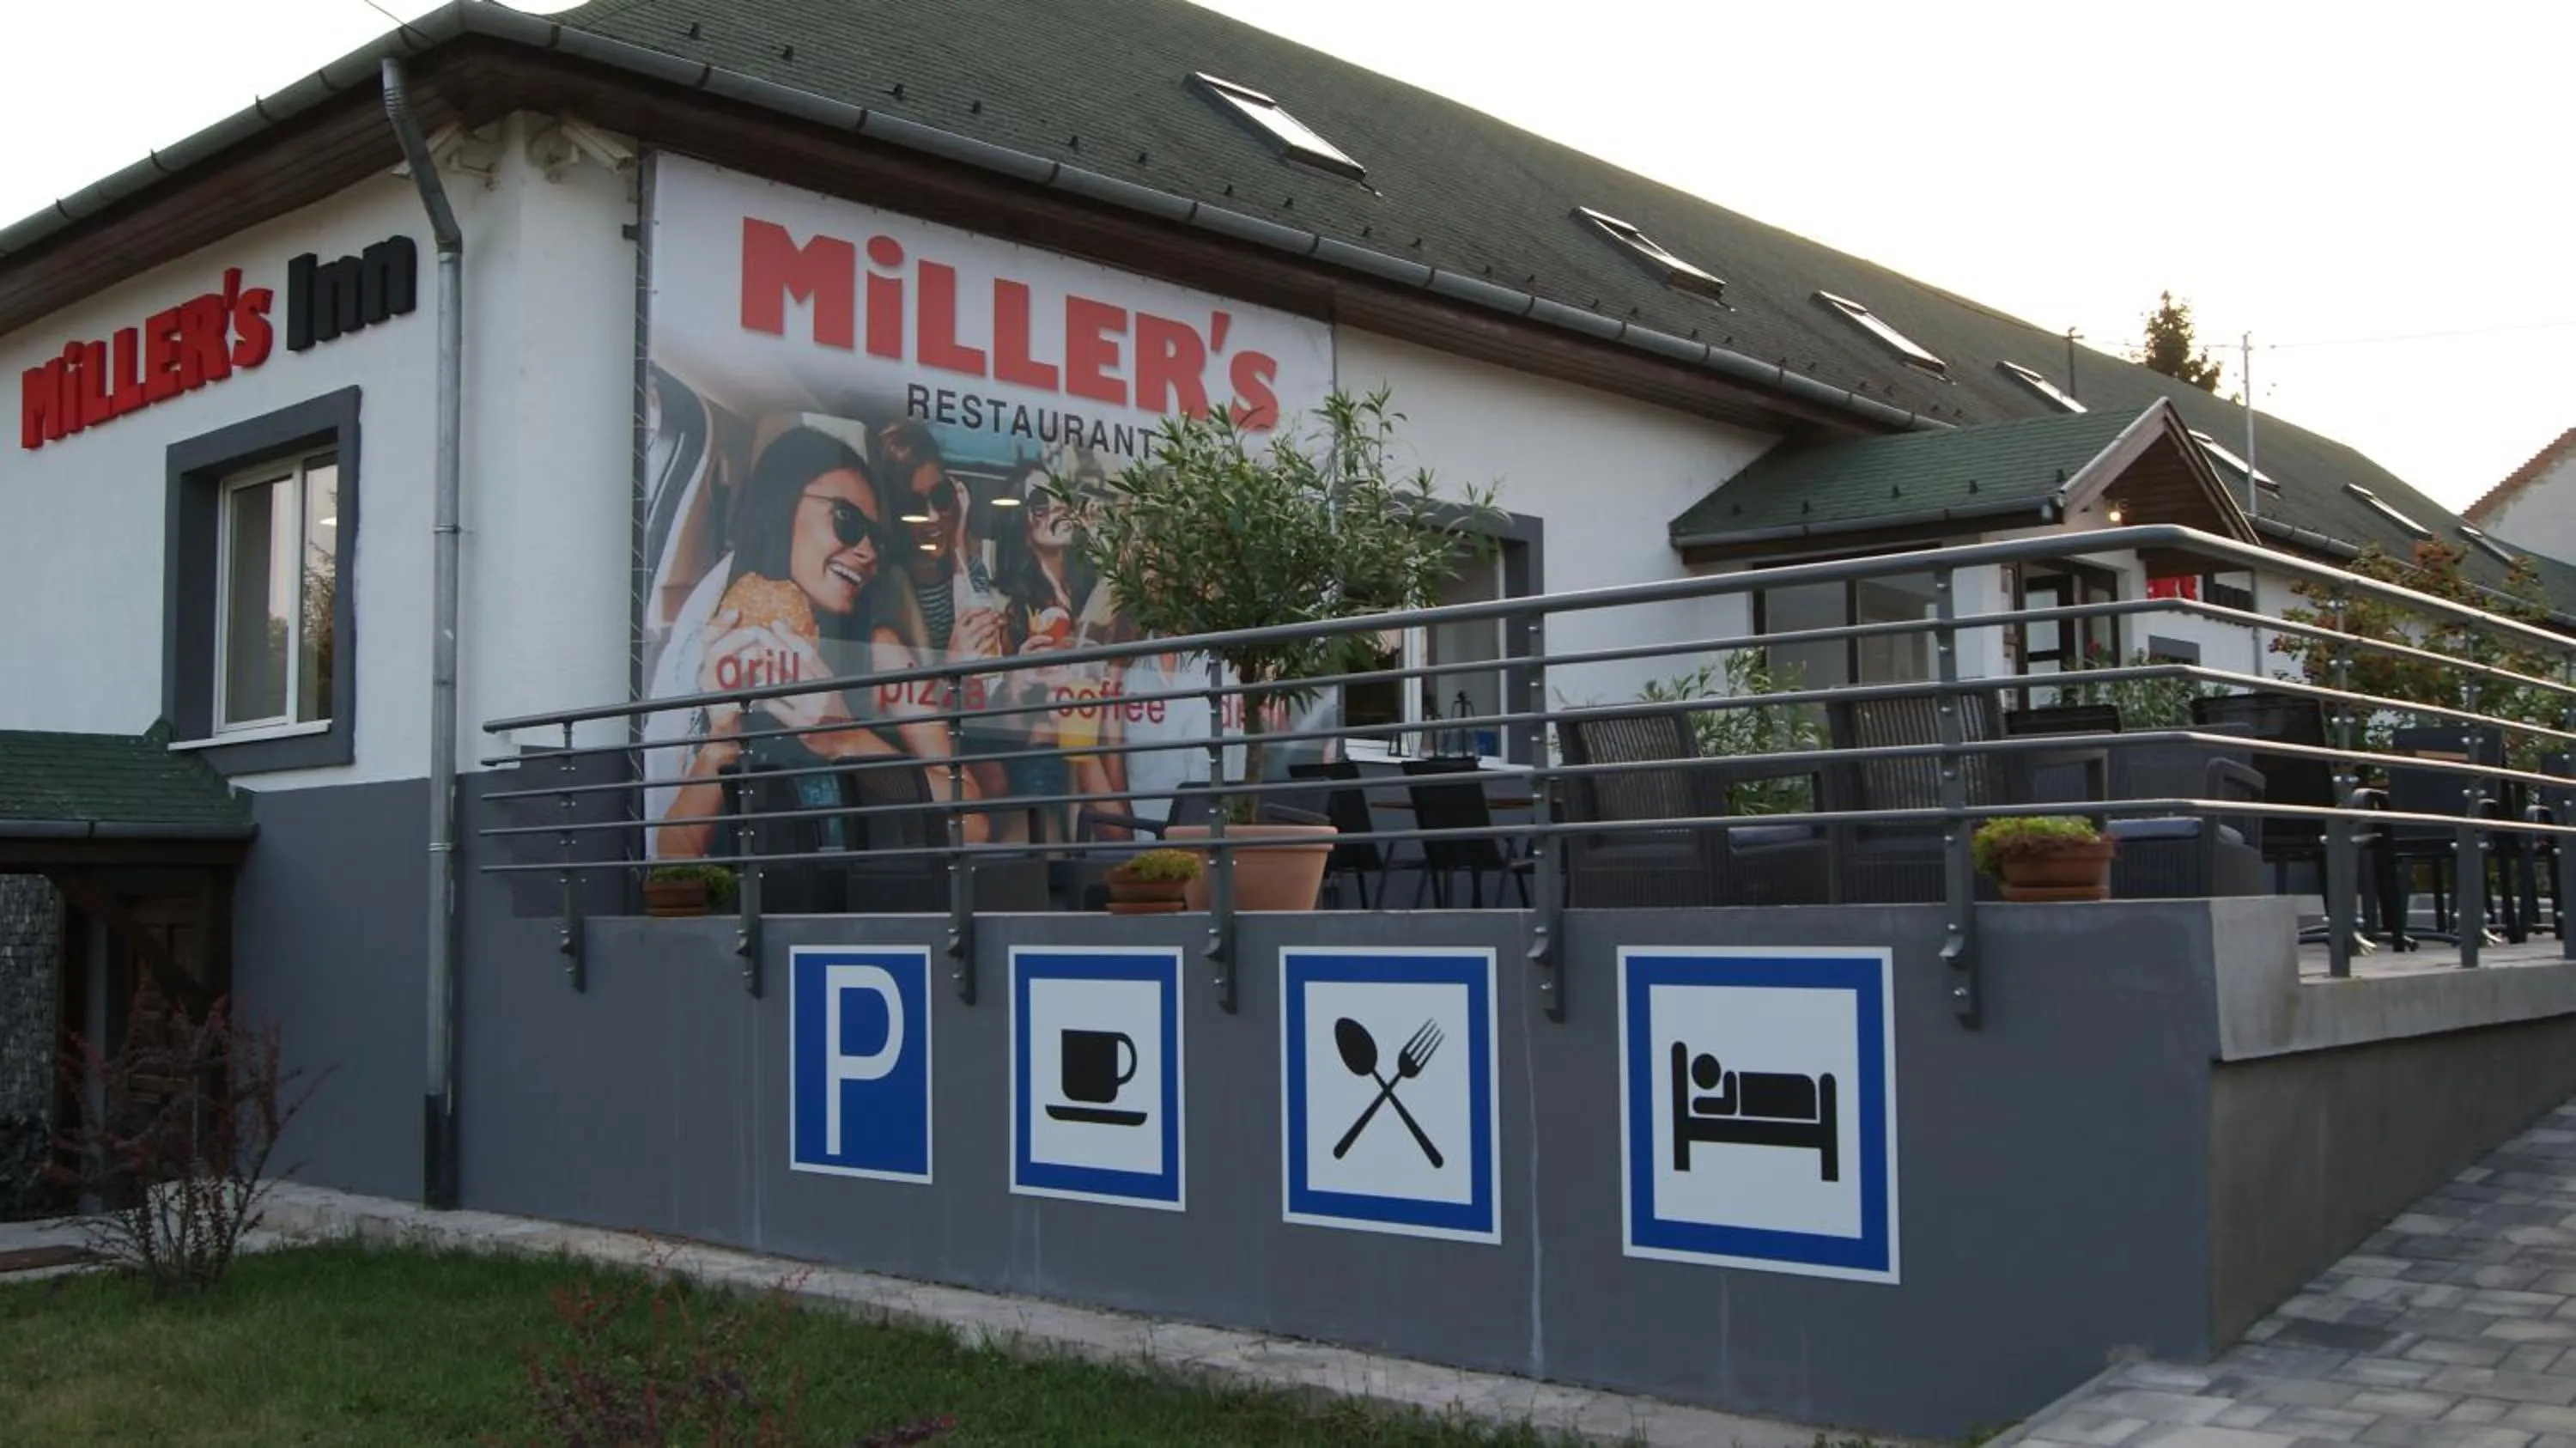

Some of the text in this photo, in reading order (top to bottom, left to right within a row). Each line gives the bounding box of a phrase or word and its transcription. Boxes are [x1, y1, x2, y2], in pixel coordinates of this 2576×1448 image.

[286, 234, 417, 352] Inn
[907, 383, 1163, 459] RESTAURANT
[1054, 679, 1165, 724] coffee
[825, 964, 905, 1156] P
